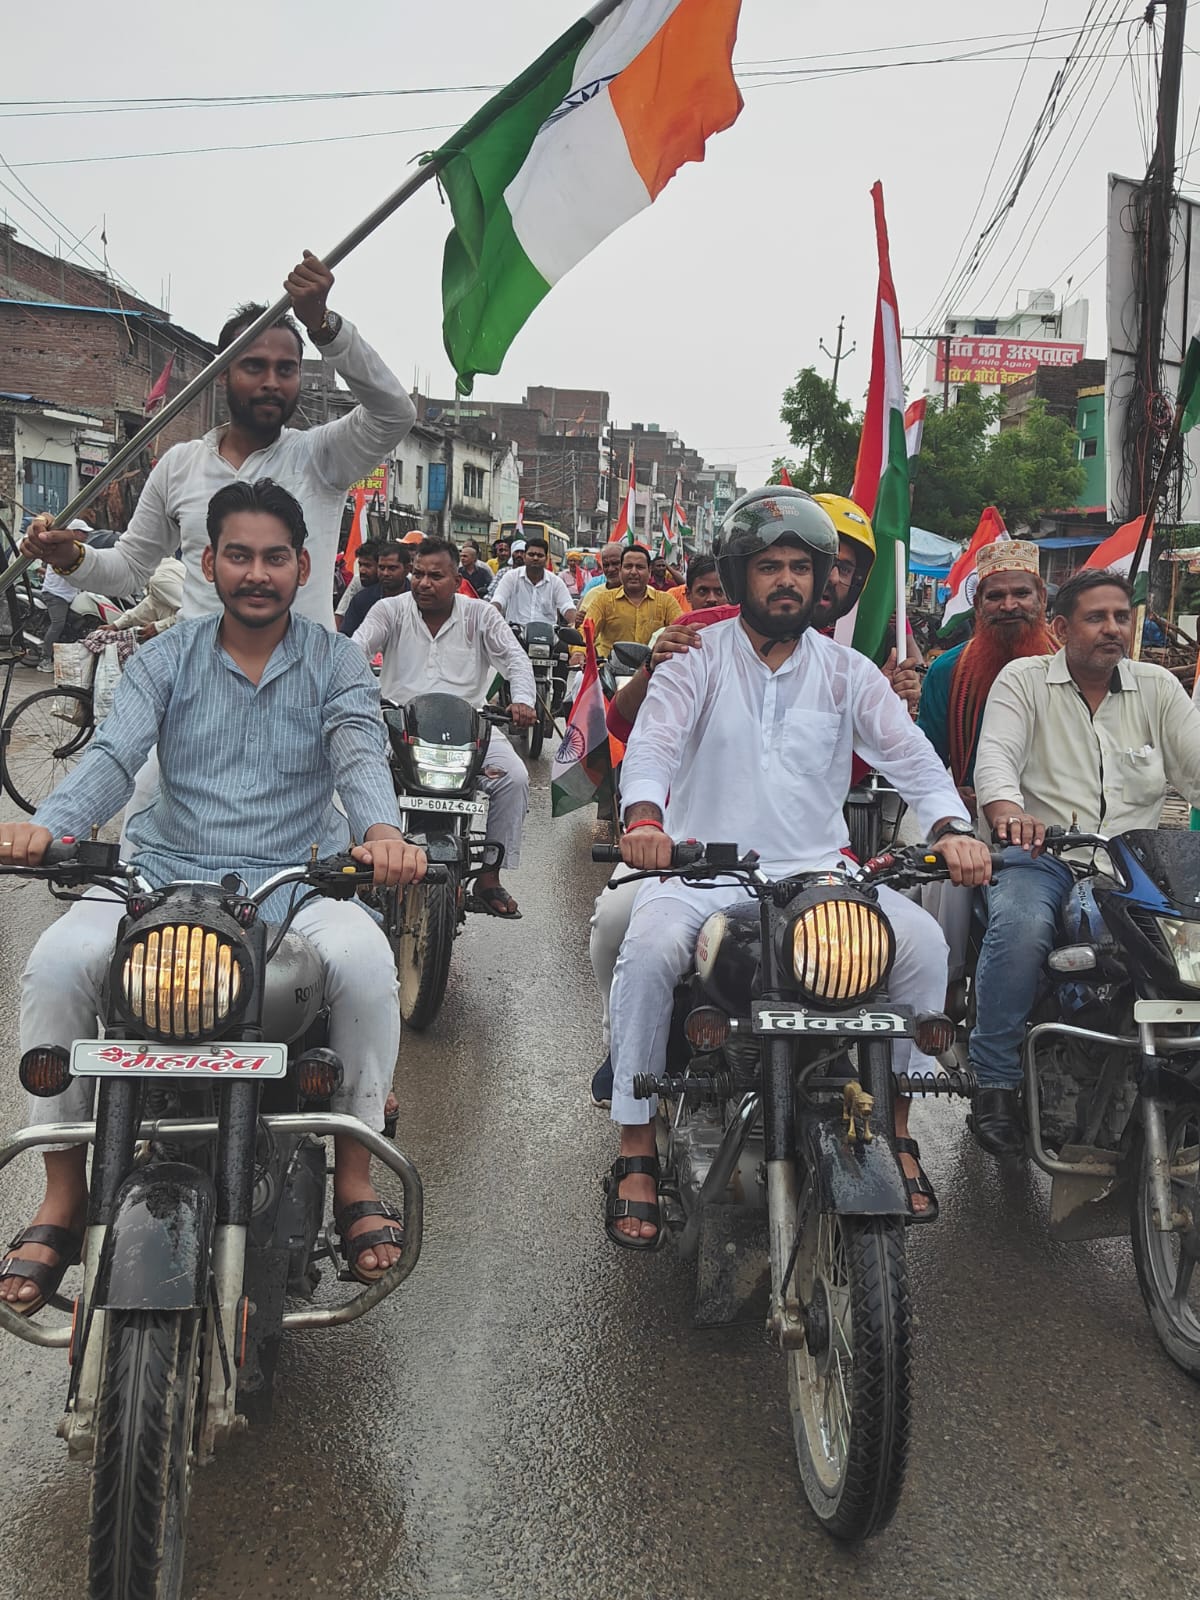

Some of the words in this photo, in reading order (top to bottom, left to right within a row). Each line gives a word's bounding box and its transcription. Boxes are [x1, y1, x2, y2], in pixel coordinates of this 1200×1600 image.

[978, 342, 1003, 358] का
[1007, 344, 1079, 363] अस्पताल
[1003, 360, 1031, 368] Again
[942, 366, 972, 381] रोज
